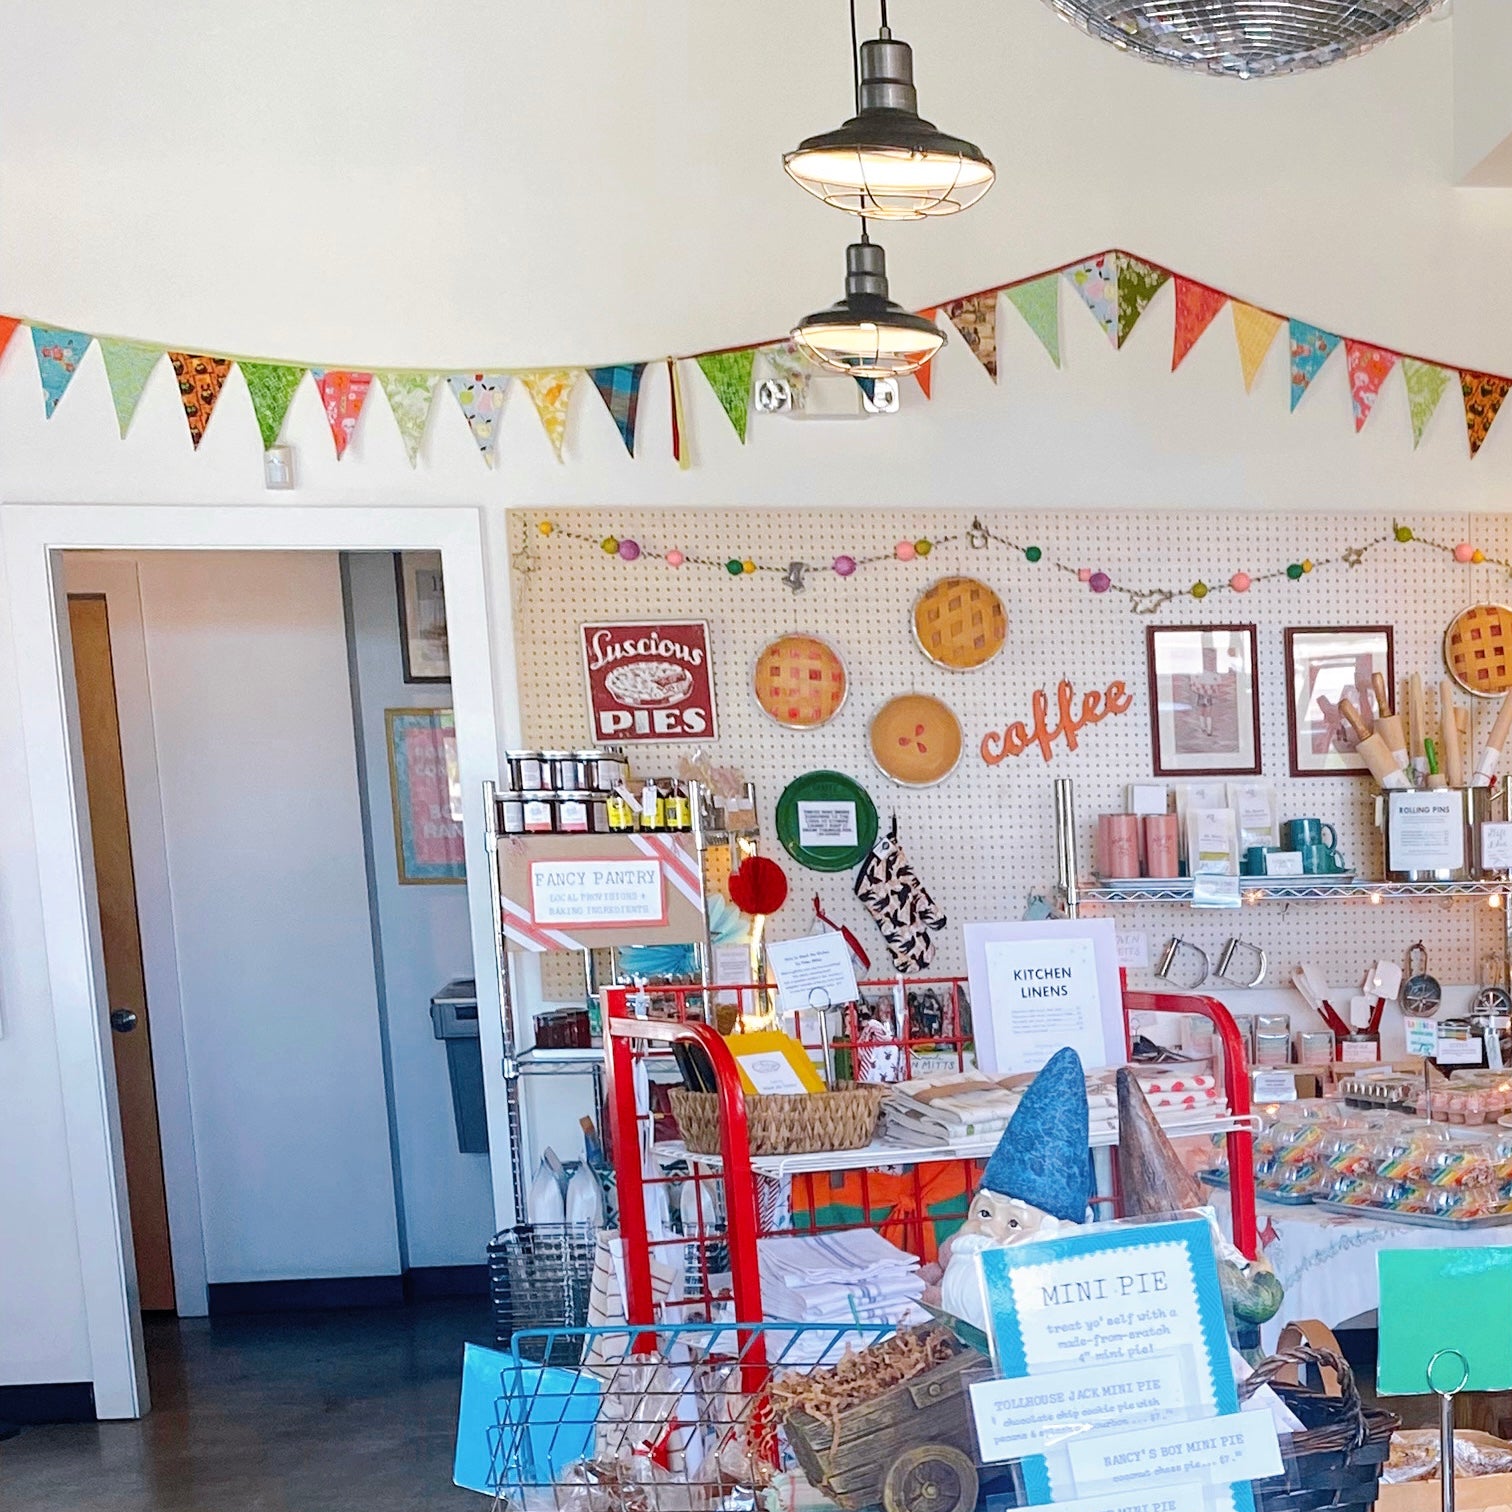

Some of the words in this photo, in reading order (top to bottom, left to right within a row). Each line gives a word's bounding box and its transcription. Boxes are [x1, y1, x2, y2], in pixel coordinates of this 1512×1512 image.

[589, 629, 705, 671] Luscious
[600, 707, 707, 735] PIES
[980, 678, 1134, 765] coffee
[1399, 806, 1430, 814] ROLLING
[535, 871, 587, 887] FANCY
[593, 870, 656, 885] PANTRY
[1013, 967, 1072, 981] KITCHEN
[1021, 985, 1068, 998] LINENS
[1041, 1278, 1108, 1306] MINI
[1116, 1270, 1168, 1296] PIE
[1046, 1320, 1082, 1333] treat
[1106, 1313, 1134, 1326] self
[1137, 1308, 1166, 1321] with
[1169, 1309, 1177, 1317] a
[1095, 1347, 1124, 1360] mini
[994, 1392, 1066, 1412] TOLLHOUSE
[1068, 1387, 1100, 1401] JACK
[1102, 1382, 1133, 1397] MINI
[1137, 1379, 1161, 1392] PIE
[1103, 1448, 1157, 1467] NANCY'S
[1160, 1444, 1183, 1456] BOY
[1186, 1438, 1217, 1452] MINI
[1220, 1433, 1244, 1447] PIE
[1152, 1500, 1176, 1512] PIE
